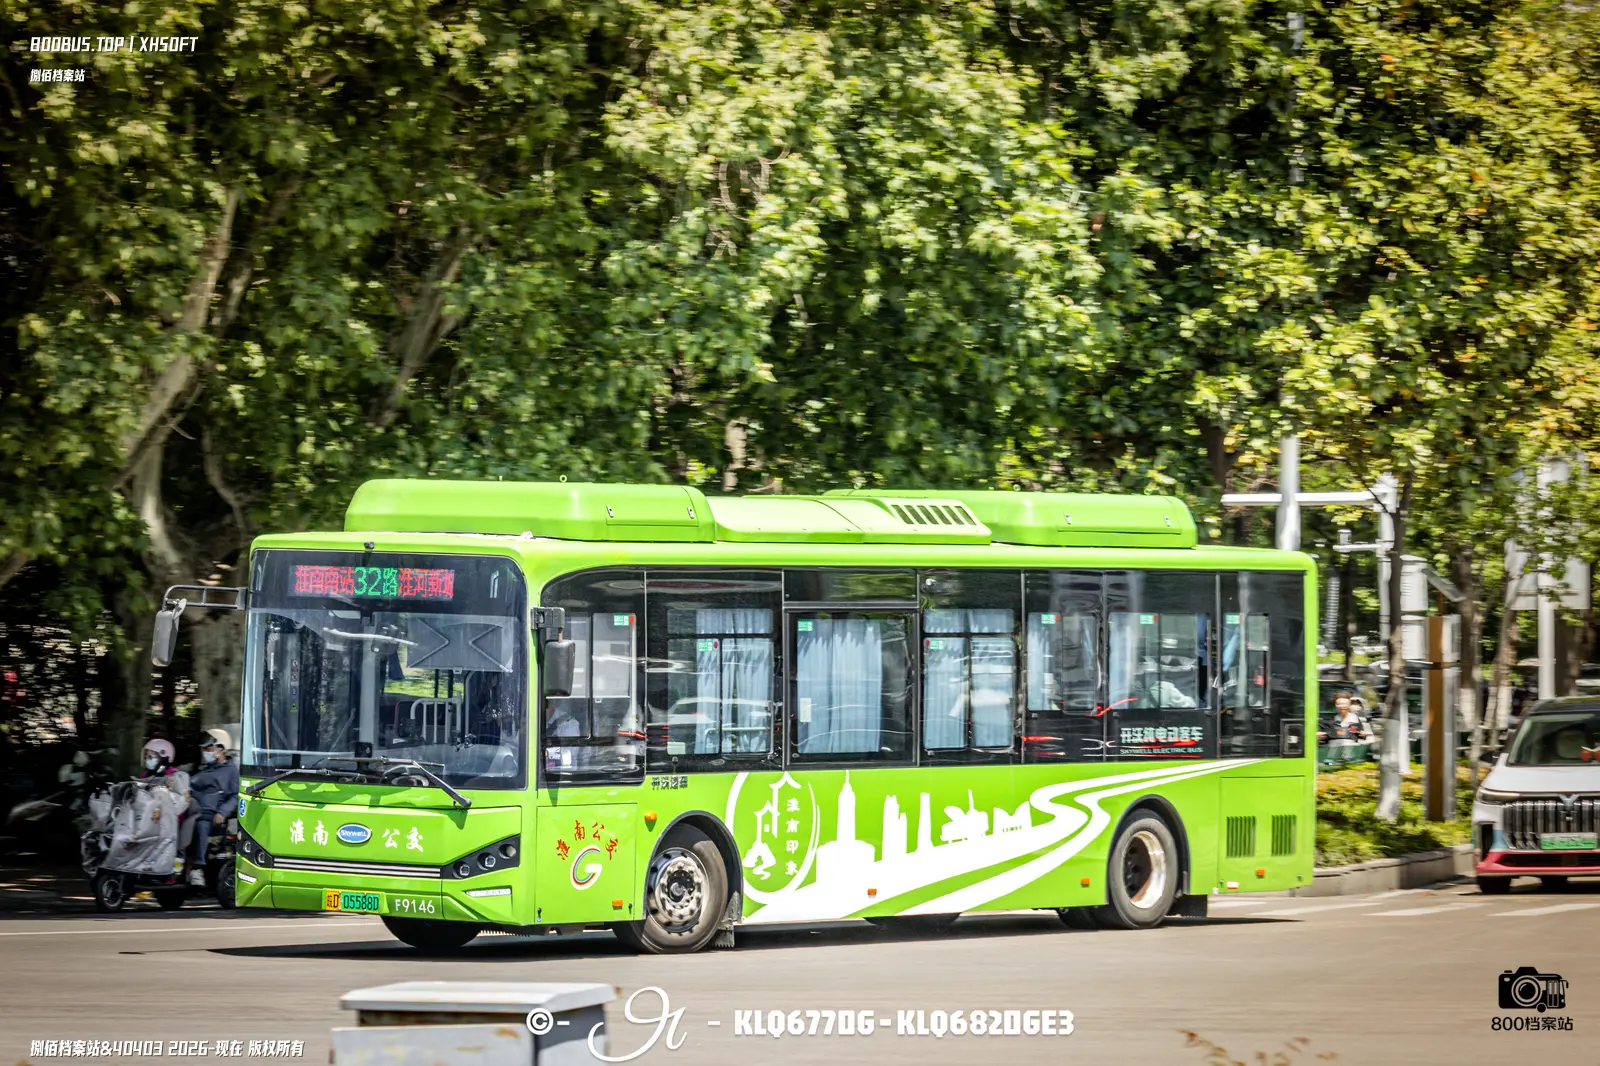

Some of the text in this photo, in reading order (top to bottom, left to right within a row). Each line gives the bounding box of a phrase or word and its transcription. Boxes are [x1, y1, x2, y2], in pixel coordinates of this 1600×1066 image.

[289, 818, 424, 852] 淮南 公交
[395, 898, 435, 913] F9146
